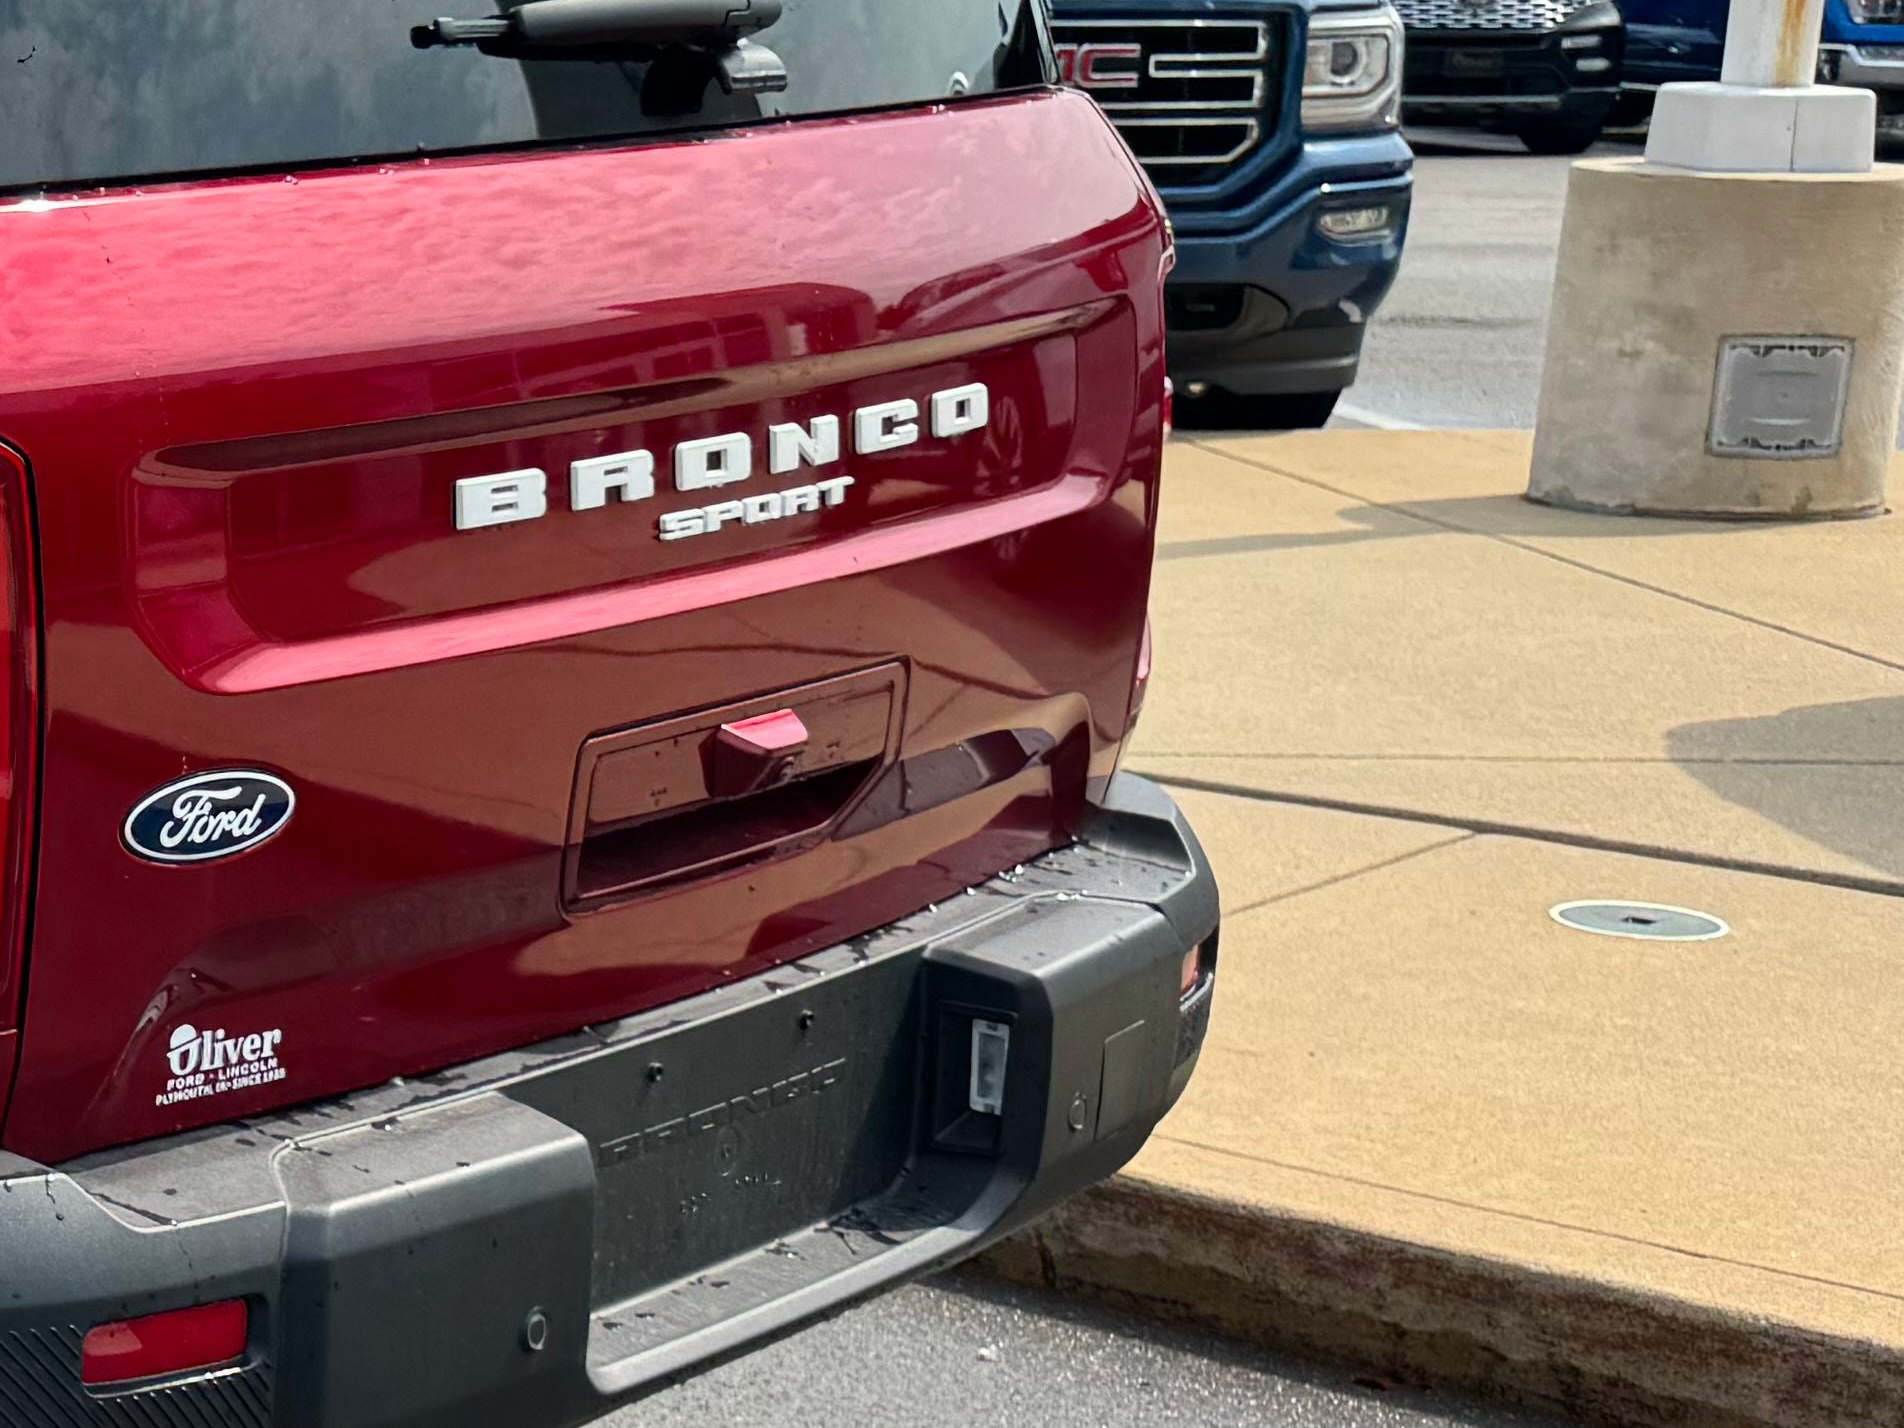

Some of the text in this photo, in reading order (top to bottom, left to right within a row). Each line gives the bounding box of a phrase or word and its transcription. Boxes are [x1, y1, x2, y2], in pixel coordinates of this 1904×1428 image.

[454, 381, 989, 531] BRONCO
[657, 475, 856, 542] SPORT
[159, 785, 267, 848] Ford
[166, 1023, 282, 1076] Oliver
[166, 1057, 278, 1091] FORD LINCOLN
